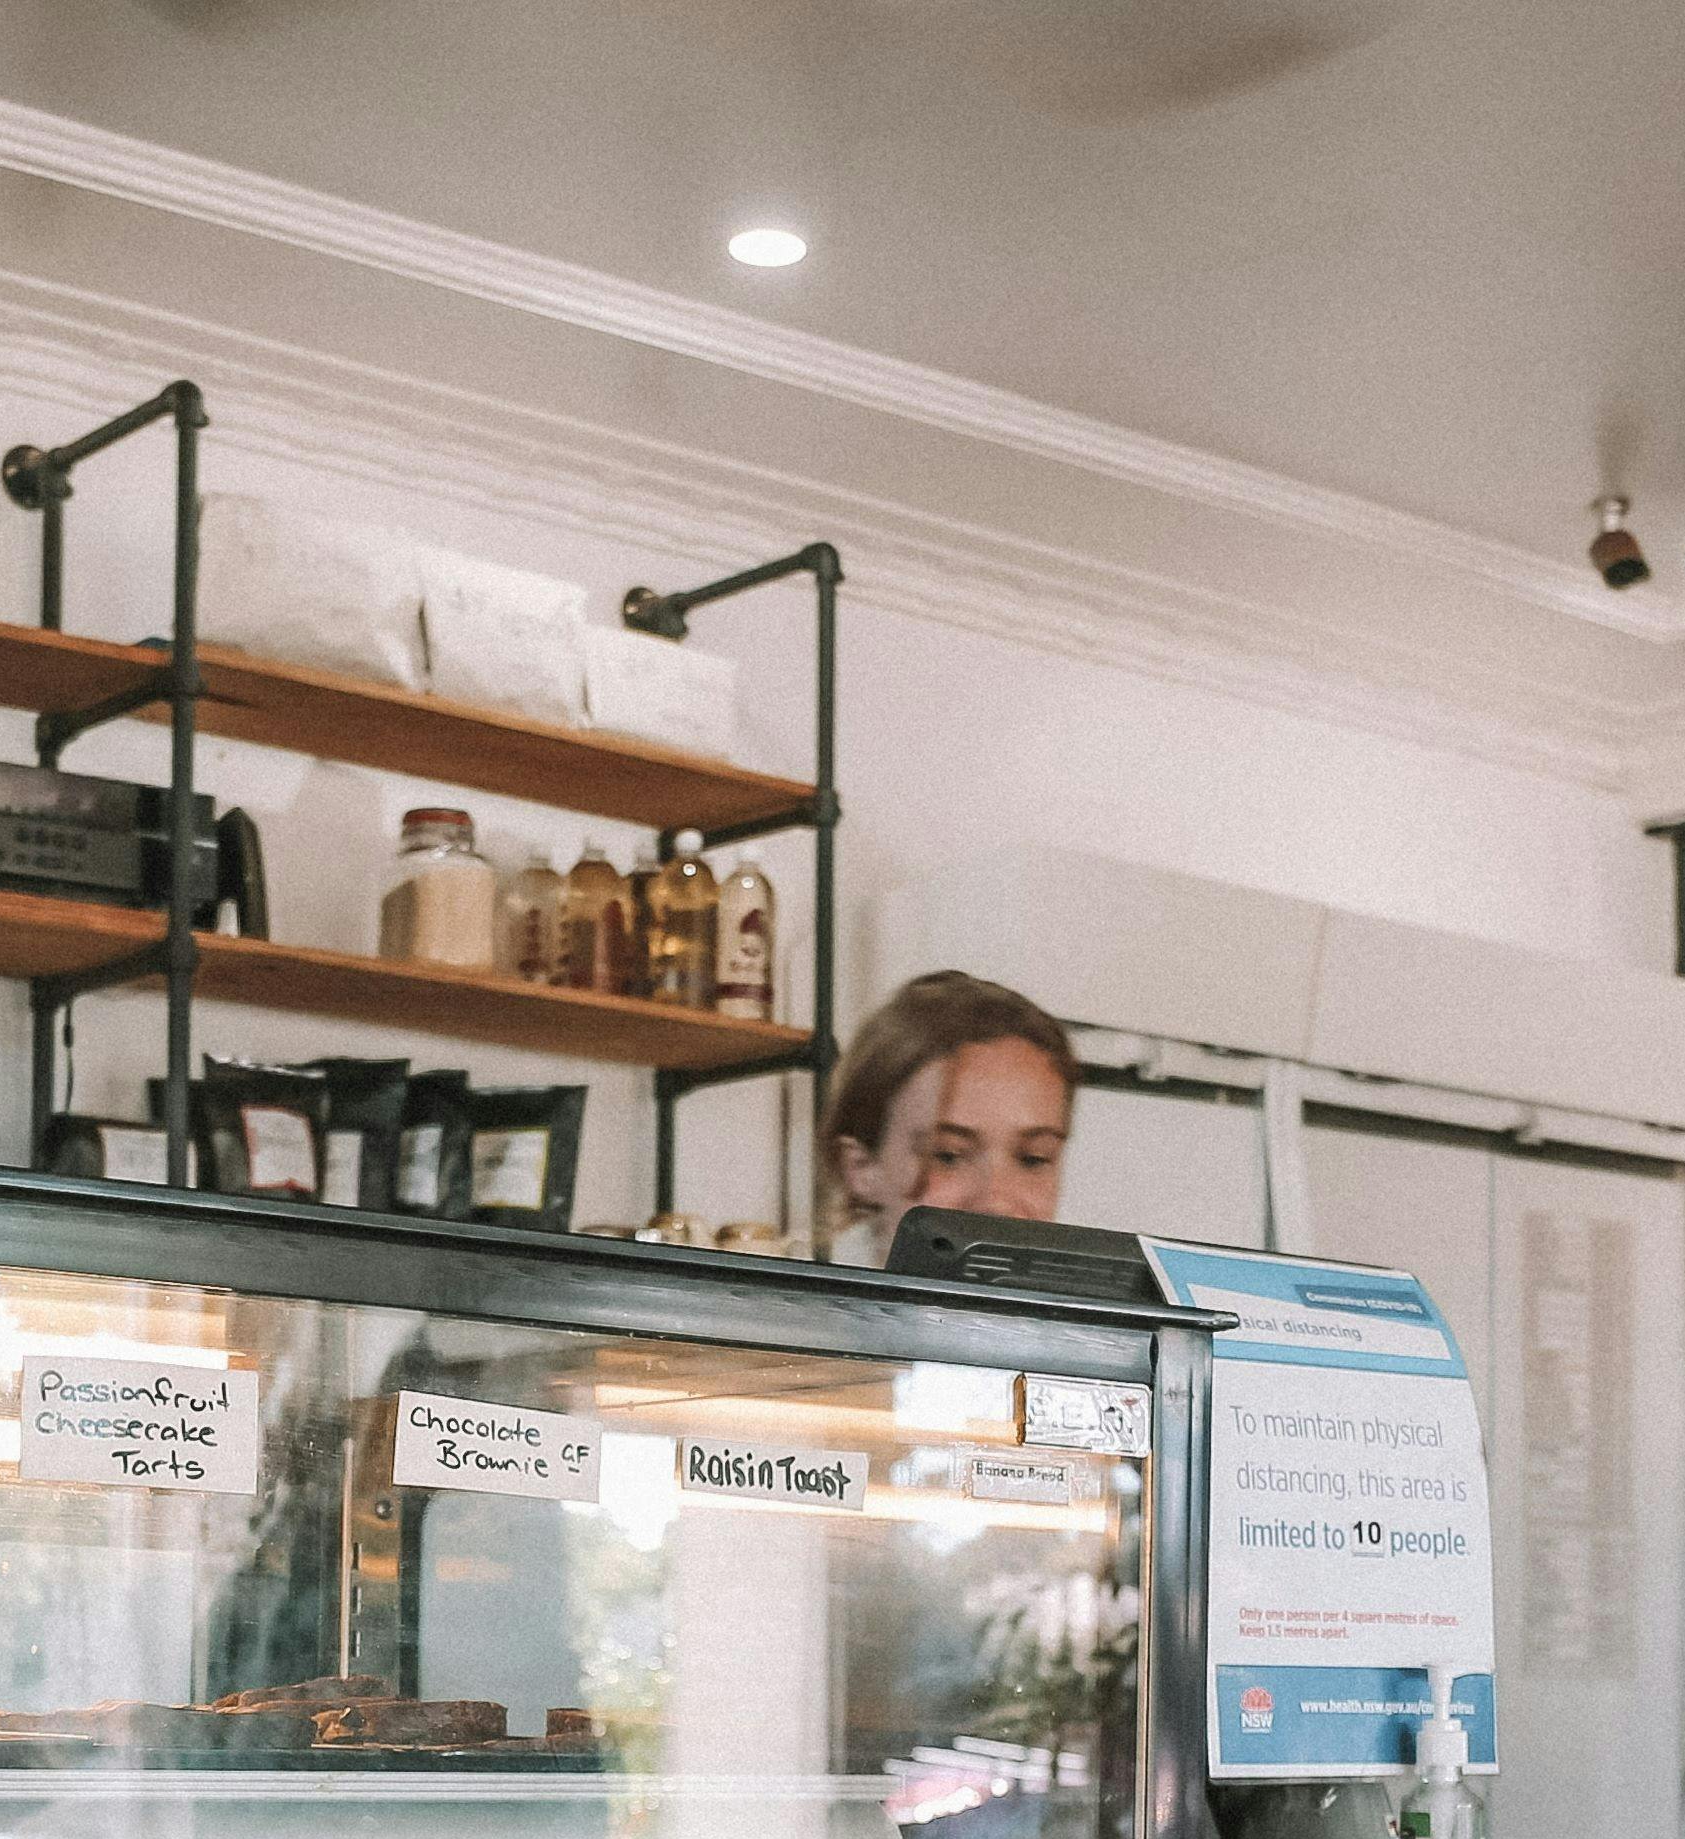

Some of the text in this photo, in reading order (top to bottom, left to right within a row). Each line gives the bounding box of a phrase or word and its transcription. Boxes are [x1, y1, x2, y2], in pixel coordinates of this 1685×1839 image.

[1283, 1320, 1362, 1341] distancing
[38, 1370, 230, 1412] Passionfruit
[34, 1411, 218, 1447] Cheesecake
[410, 1406, 541, 1447] Chocolate
[1230, 1405, 1444, 1450] To maintain physical
[112, 1450, 205, 1480] Tarts
[437, 1440, 549, 1479] Brownie
[690, 1445, 851, 1500] Raisin Toast
[1236, 1462, 1466, 1501] distancing, this area is
[1239, 1517, 1315, 1548] limited
[1323, 1523, 1344, 1550] to
[1353, 1520, 1382, 1545] 10
[1239, 1607, 1262, 1621] Only
[1286, 1610, 1320, 1623] person
[1239, 1625, 1265, 1639] Keep
[1284, 1626, 1317, 1638] metres
[1241, 1712, 1274, 1729] NSW
